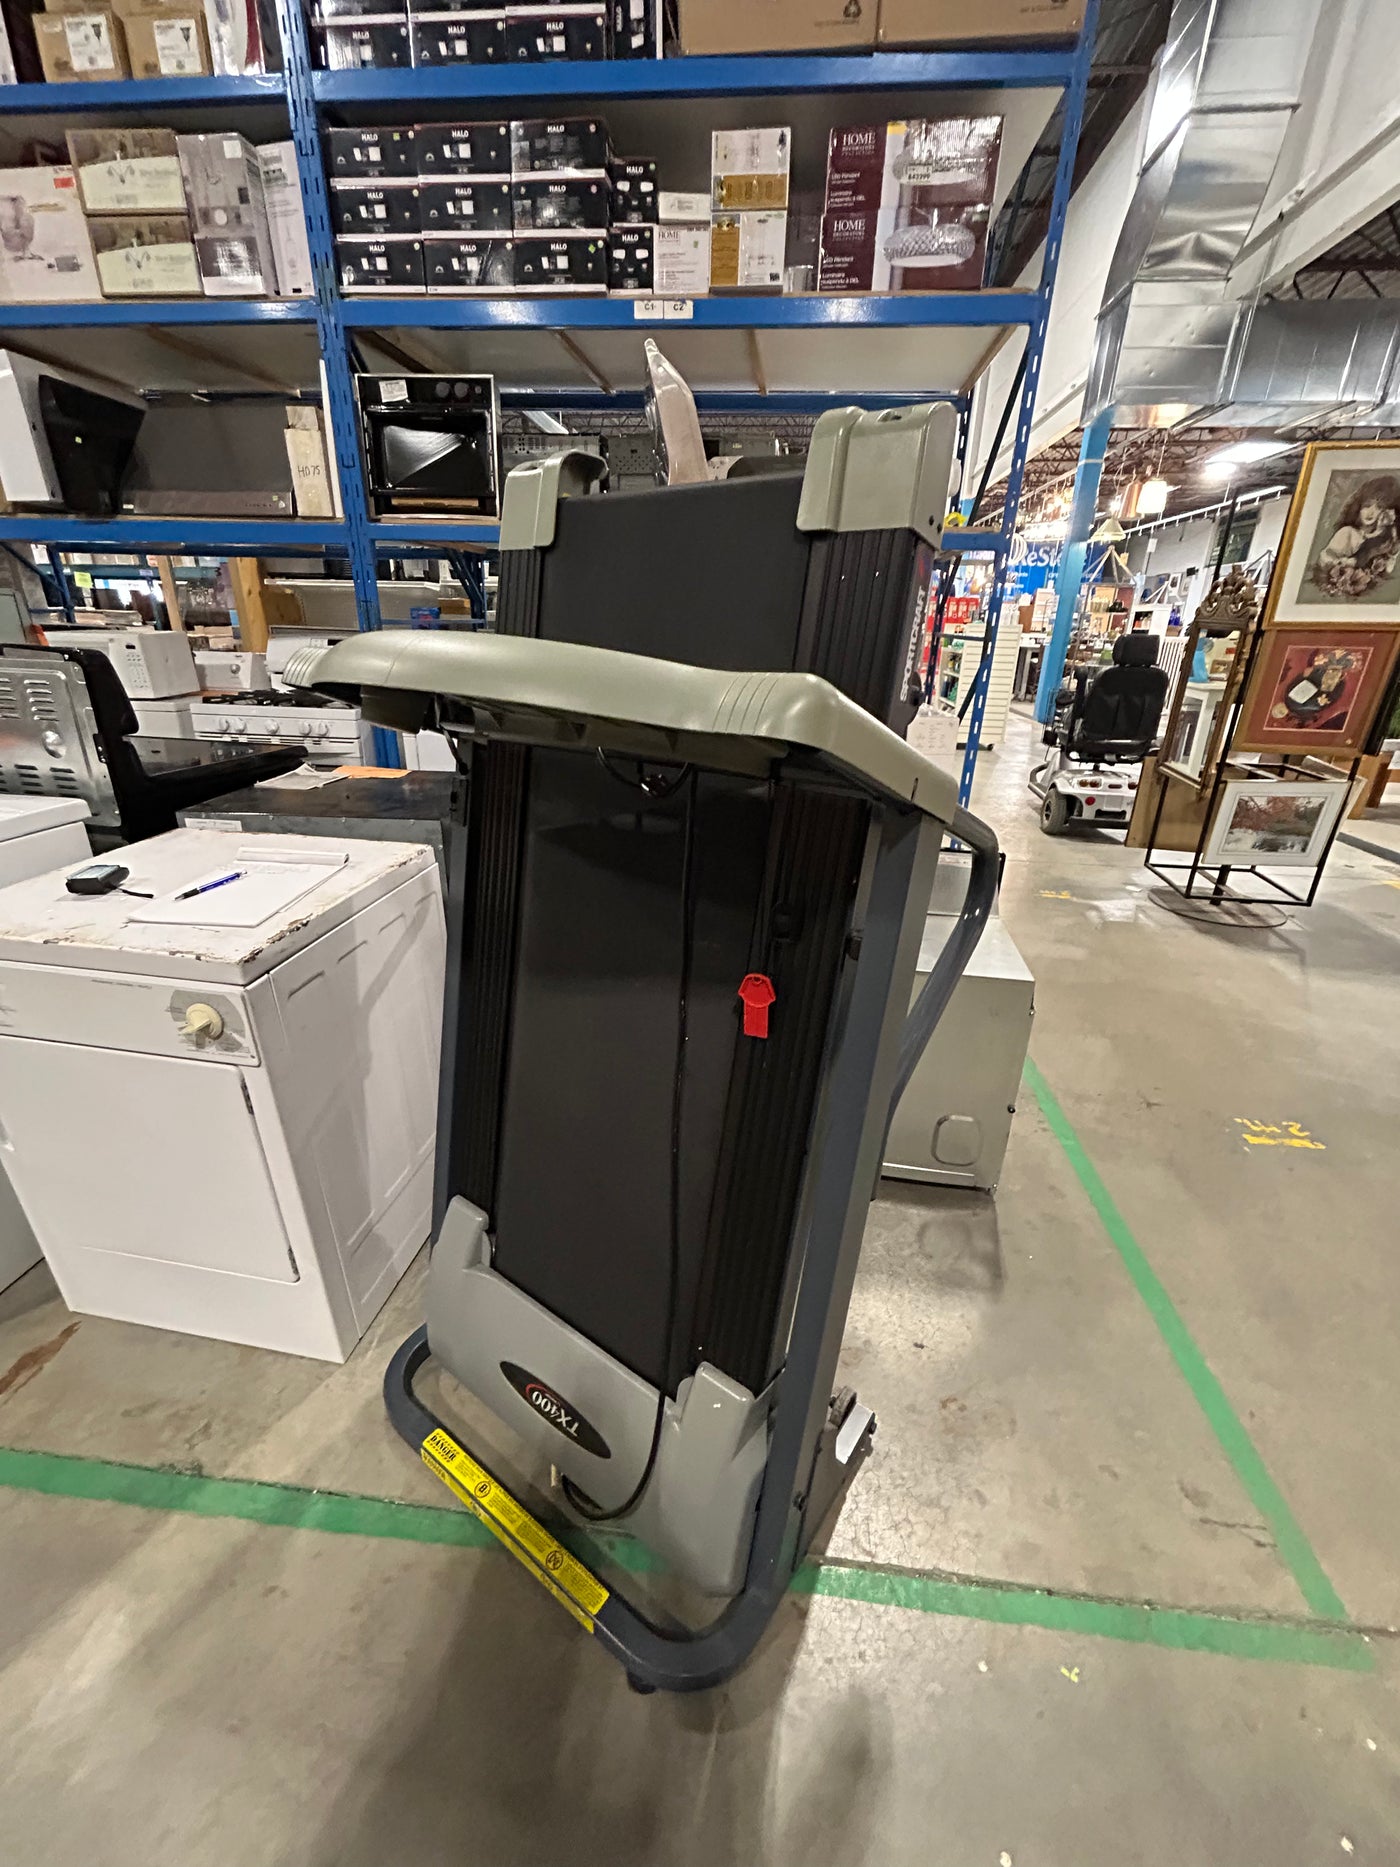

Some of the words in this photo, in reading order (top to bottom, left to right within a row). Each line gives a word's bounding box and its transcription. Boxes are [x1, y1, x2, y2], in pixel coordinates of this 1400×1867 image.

[447, 25, 466, 35] HALO
[546, 21, 564, 31] HALO
[451, 129, 469, 139] HALO
[547, 124, 565, 134] HALO
[361, 132, 378, 142] HALO
[842, 132, 876, 146] HOME
[626, 165, 644, 175] HALO
[455, 187, 472, 196] HALO
[549, 185, 567, 193] HALO
[367, 191, 384, 200] HALO
[833, 219, 866, 233] HOME
[621, 233, 640, 243] HALO
[368, 244, 386, 253] HALO
[460, 244, 477, 253] HALO
[550, 243, 568, 251] HALO
[644, 303, 655, 312] C1
[673, 303, 685, 312] C2
[531, 1390, 580, 1438] TX400
[429, 1434, 457, 1462] DANGER
